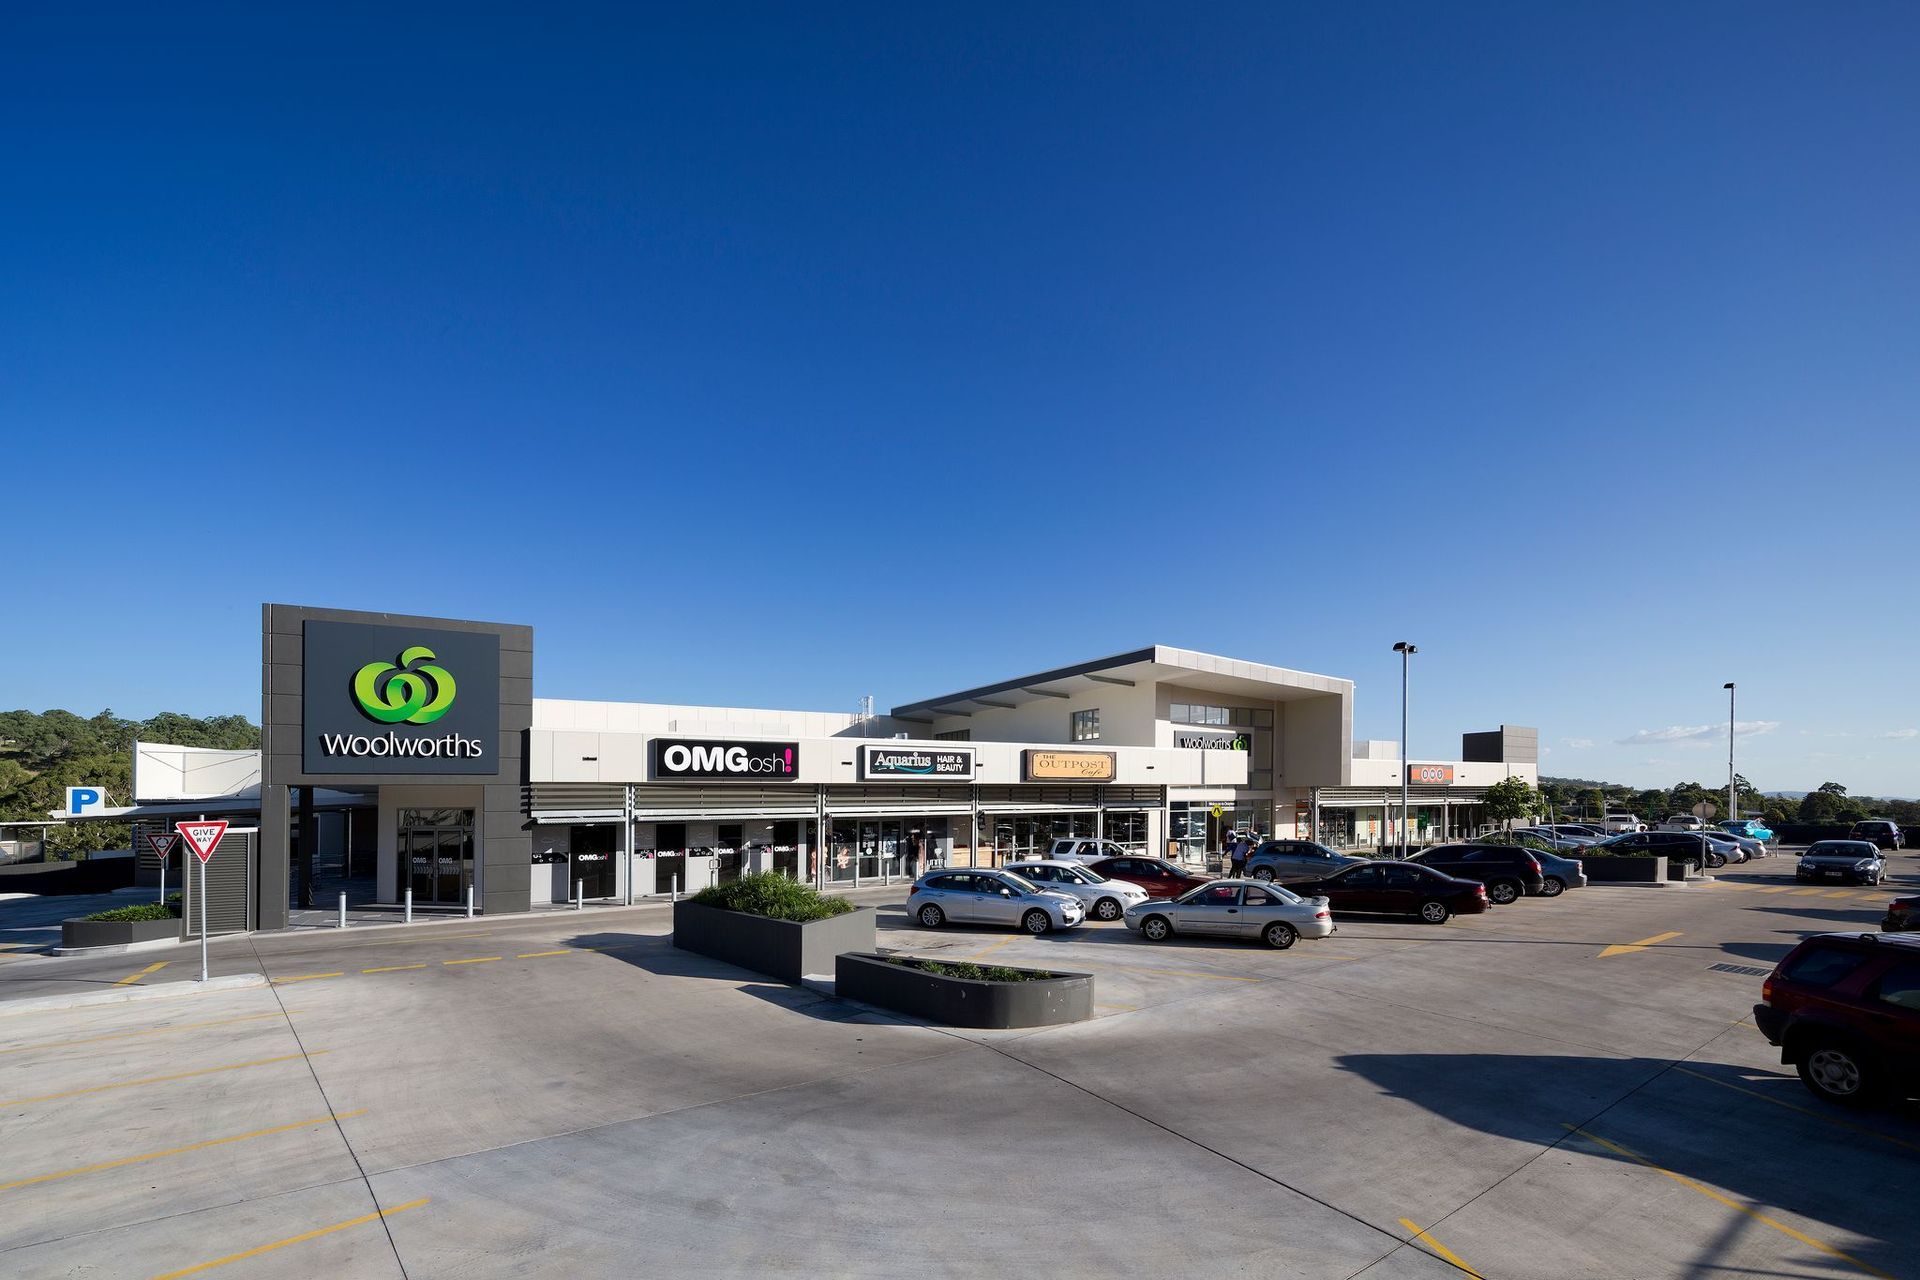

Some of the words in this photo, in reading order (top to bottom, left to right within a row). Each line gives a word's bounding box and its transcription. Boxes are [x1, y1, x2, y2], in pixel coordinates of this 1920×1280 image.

[323, 731, 483, 757] Woolworths
[1183, 737, 1231, 750] Woolworths
[664, 744, 792, 773] OMGosh!
[874, 751, 932, 770] Aquarius
[936, 755, 955, 763] HAIR
[956, 756, 963, 764] &
[1039, 760, 1107, 769] OUTPOST
[936, 763, 964, 772] BEAUTY
[71, 788, 99, 814] P
